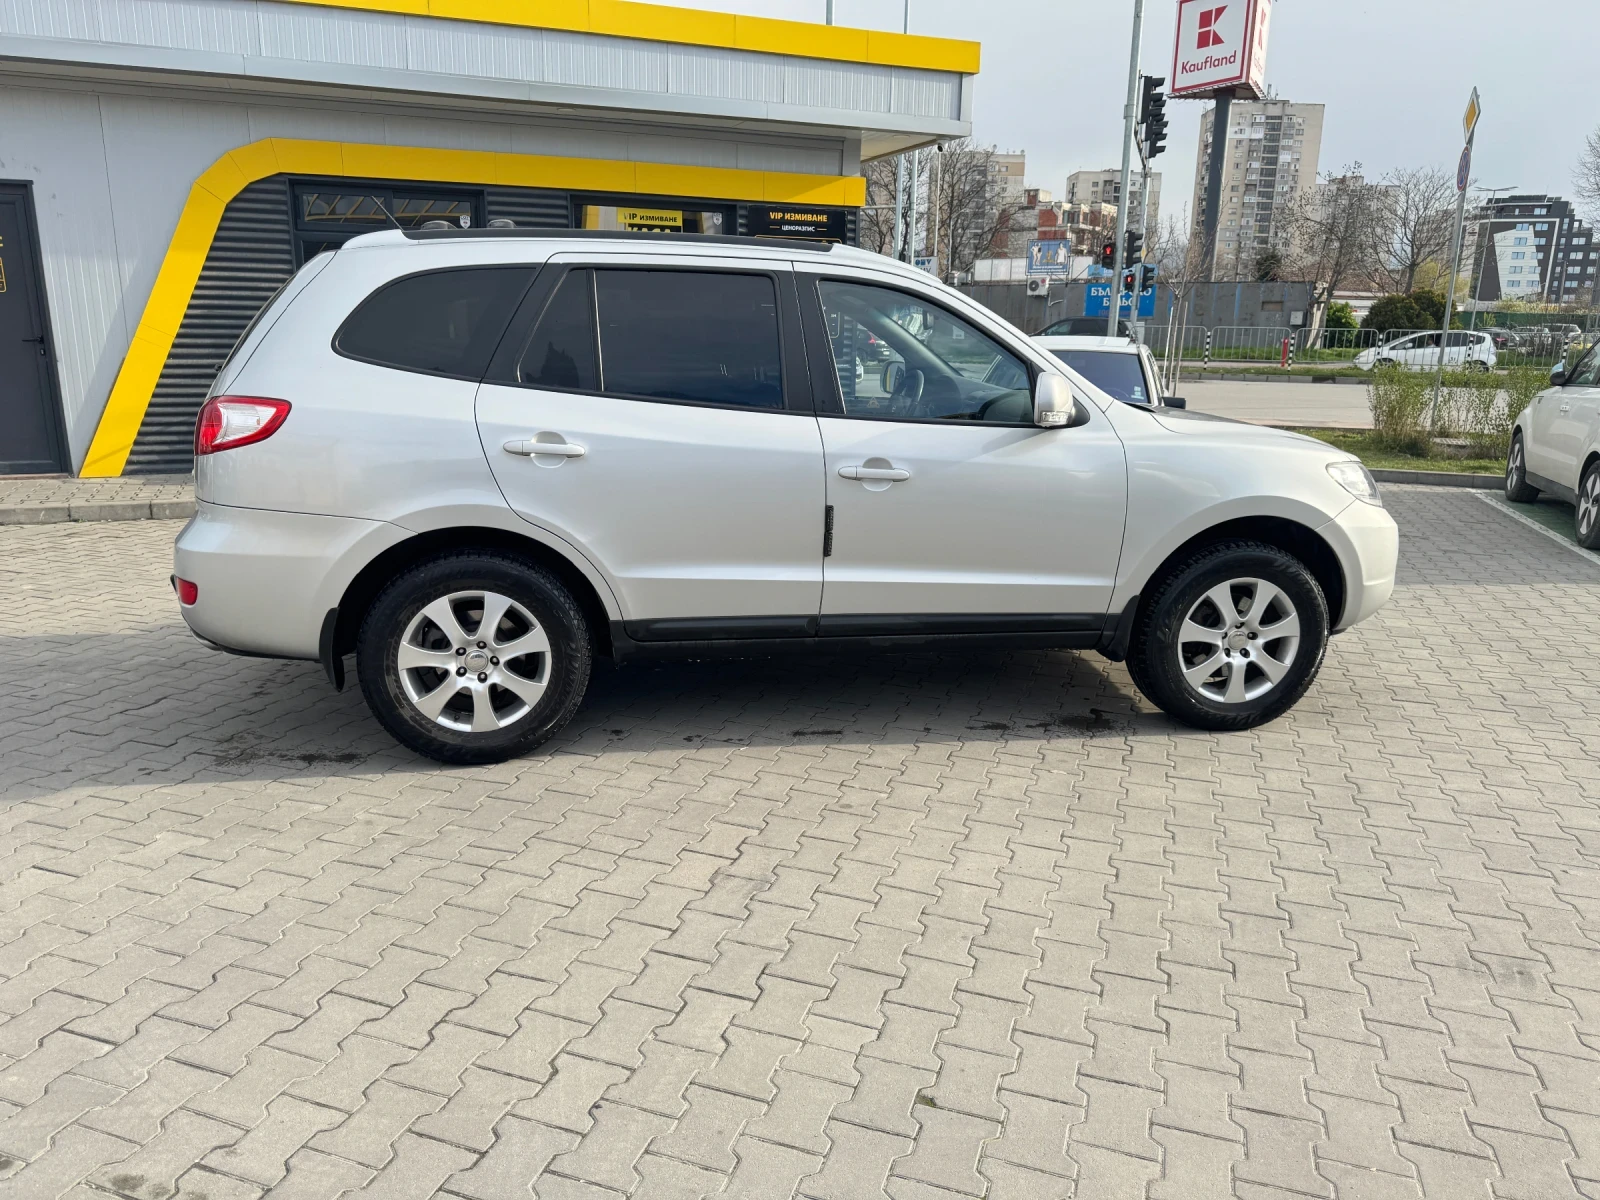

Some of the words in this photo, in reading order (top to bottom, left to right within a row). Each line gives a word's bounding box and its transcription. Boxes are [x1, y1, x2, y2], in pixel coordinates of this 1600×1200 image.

[1180, 49, 1237, 75] Kaufland
[623, 212, 638, 221] VIP
[639, 214, 678, 223] ИЗМИВАНЕ
[769, 211, 783, 220] VIP
[784, 212, 828, 222] ИЗМИВАНЕ
[781, 224, 816, 232] ЦЕНОРАЗПИС
